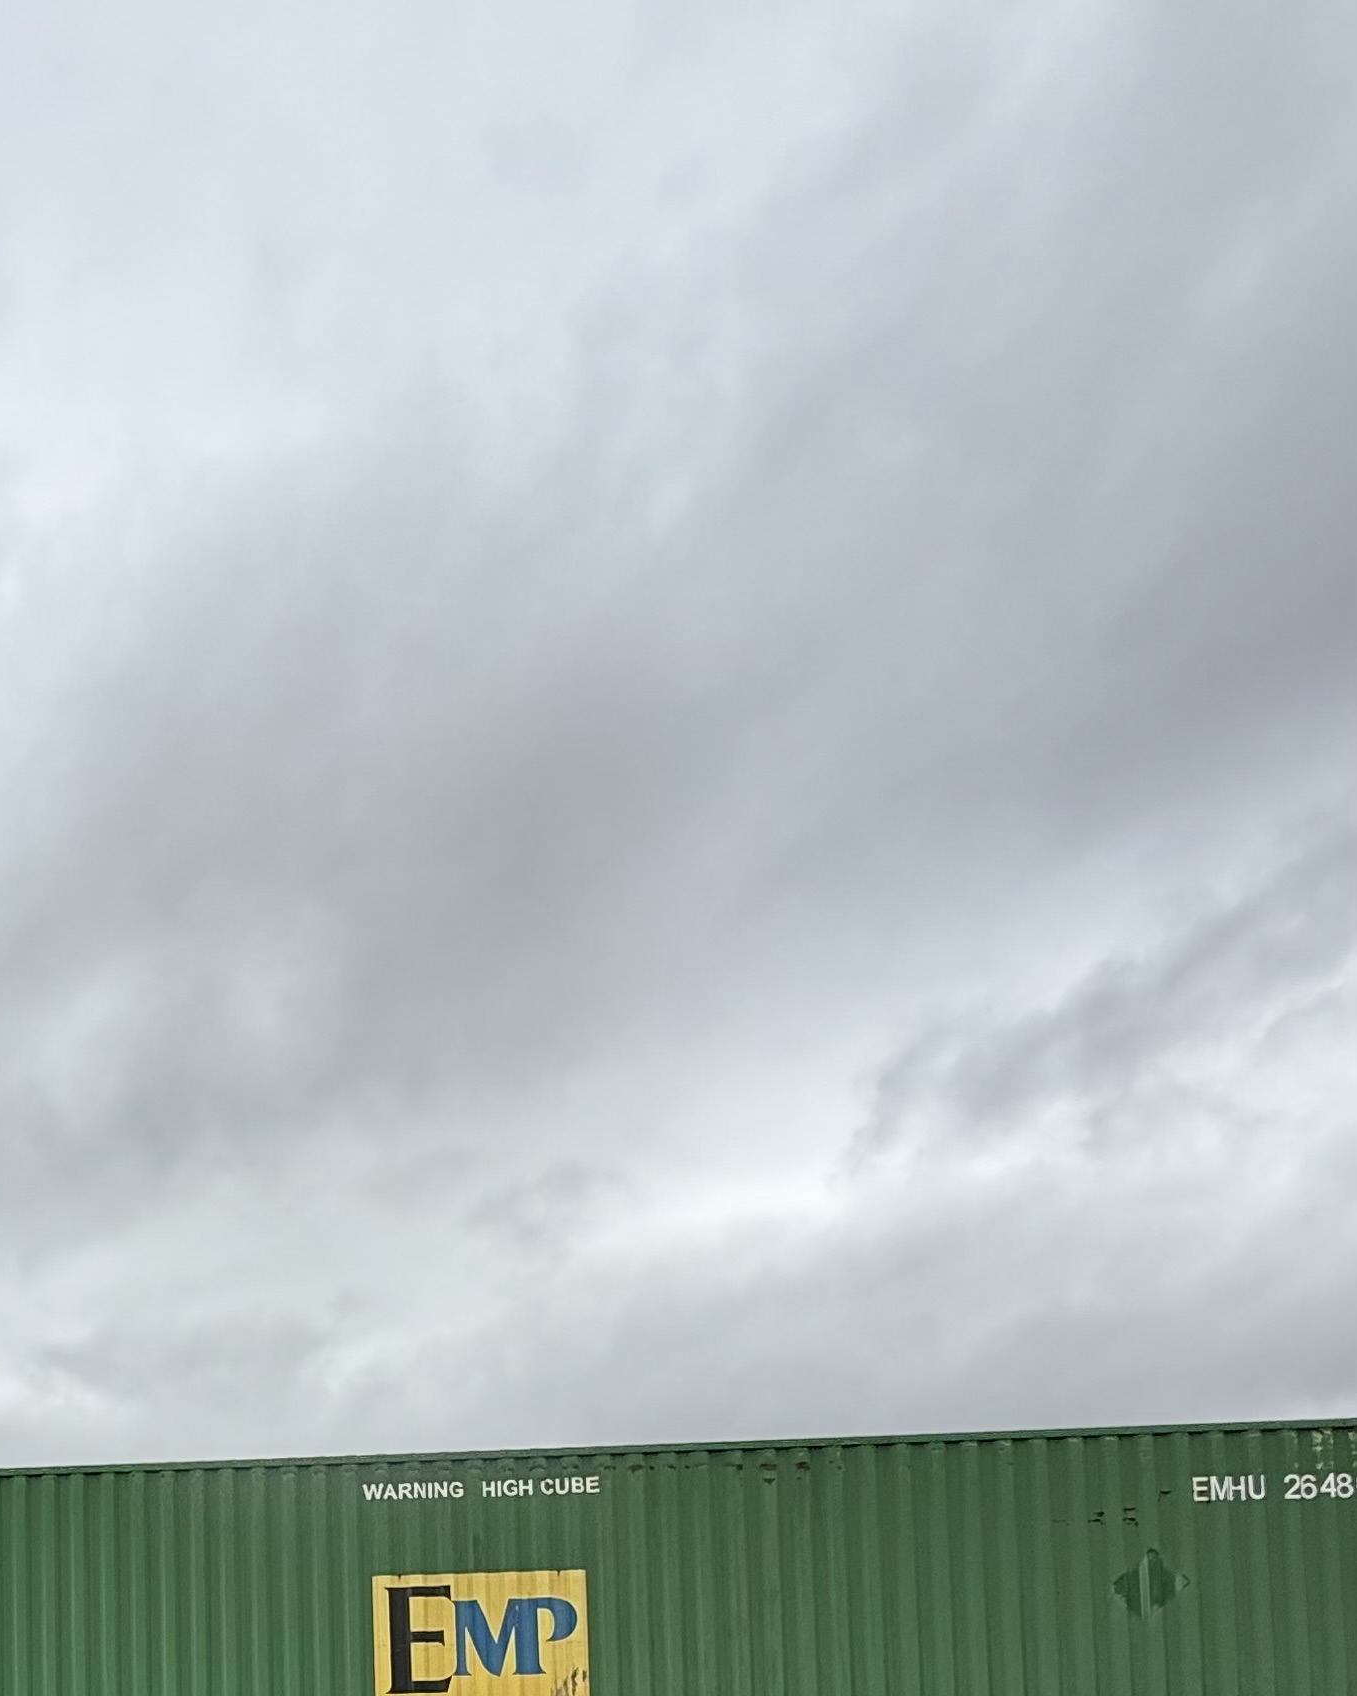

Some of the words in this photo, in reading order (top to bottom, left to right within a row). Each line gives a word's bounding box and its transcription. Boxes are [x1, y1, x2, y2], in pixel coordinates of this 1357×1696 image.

[362, 1481, 465, 1500] WARNING
[481, 1479, 533, 1498] HIGH
[539, 1476, 600, 1495] CUBE
[1192, 1474, 1265, 1502] EMHU
[1283, 1472, 1357, 1500] 2648
[384, 1584, 578, 1694] EMP
